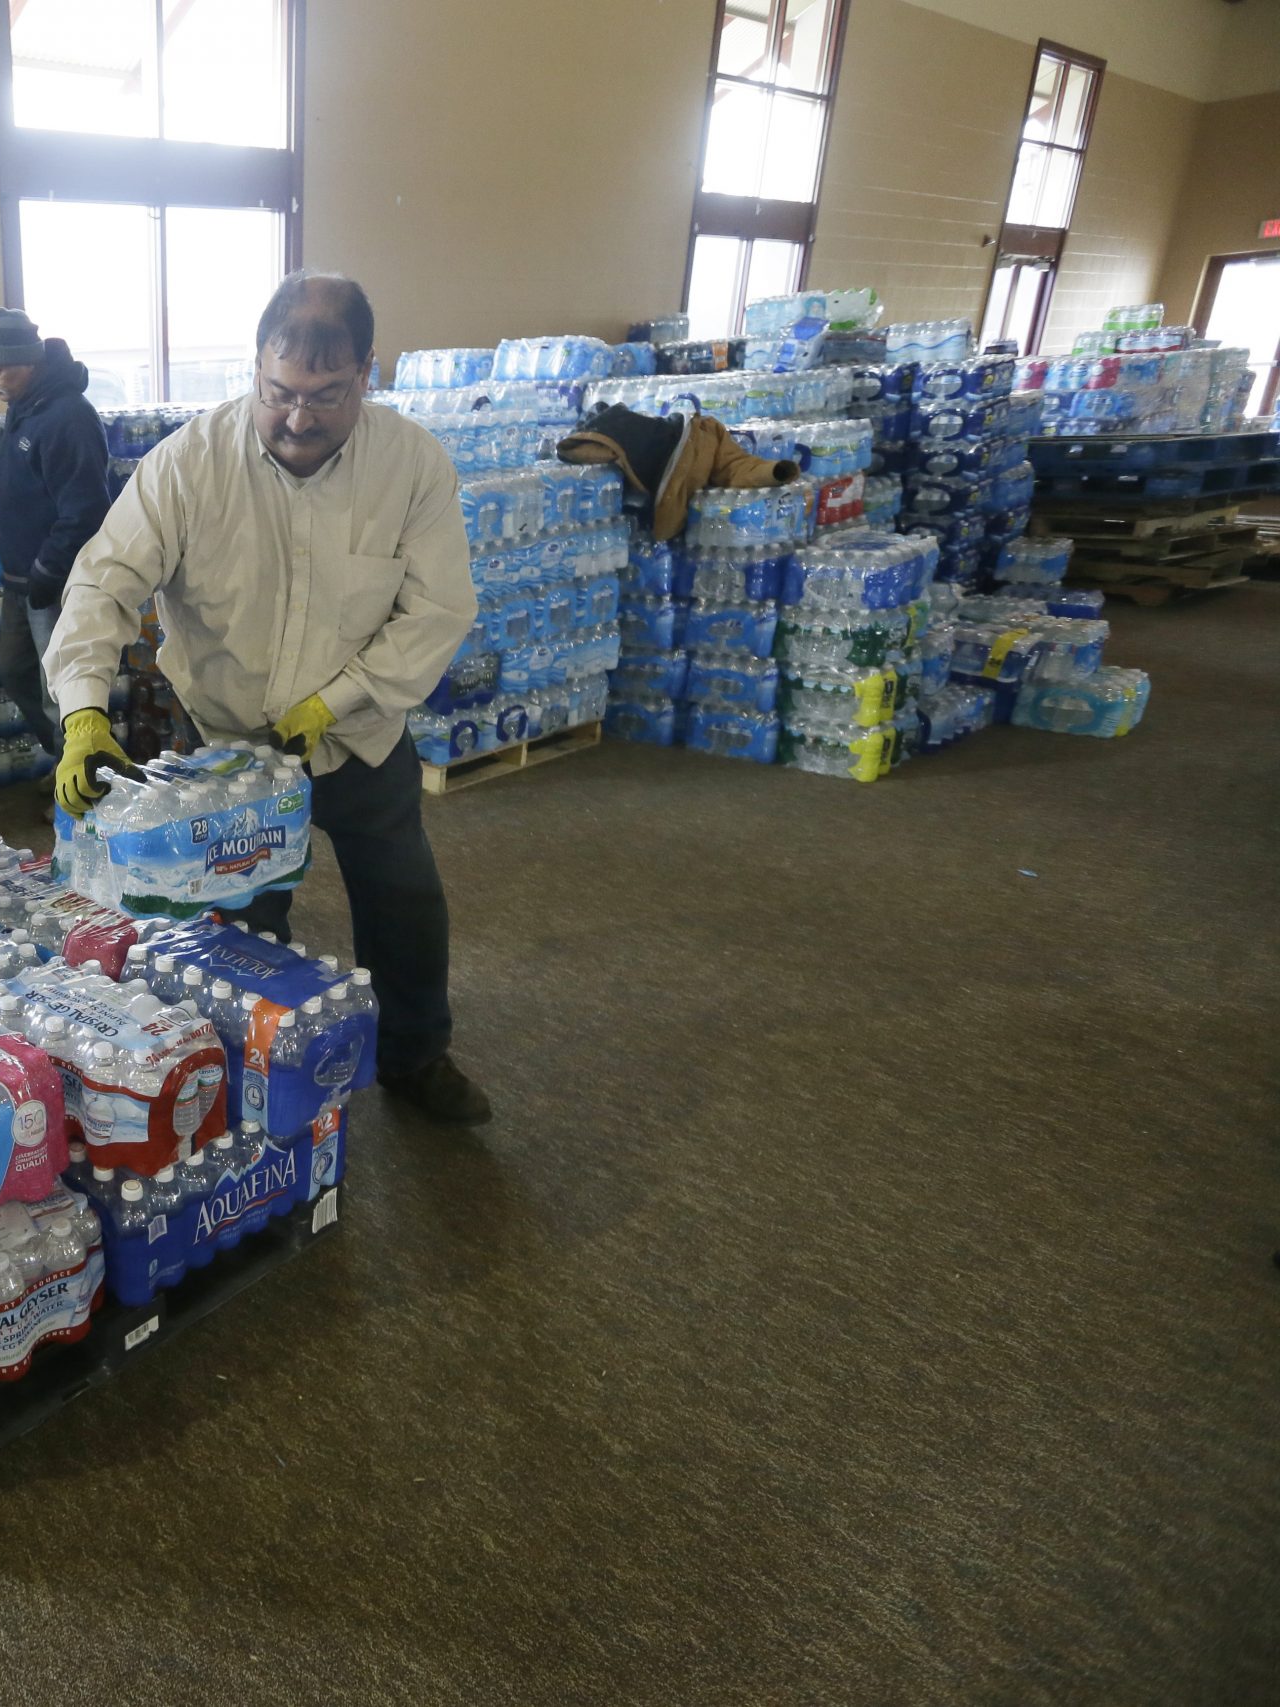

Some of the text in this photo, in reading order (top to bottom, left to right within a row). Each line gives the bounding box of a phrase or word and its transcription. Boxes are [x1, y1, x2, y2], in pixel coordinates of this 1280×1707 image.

[1263, 220, 1280, 238] EX
[193, 819, 208, 836] 28
[207, 830, 282, 865] ICE MOUAIN
[25, 990, 119, 1037] CRYSTAL GESER
[250, 1048, 266, 1069] 24
[18, 1108, 44, 1131] 150
[193, 1148, 297, 1245] AQUAFINA
[20, 1282, 69, 1320] GEYSER
[3, 1320, 33, 1343] SPRING
